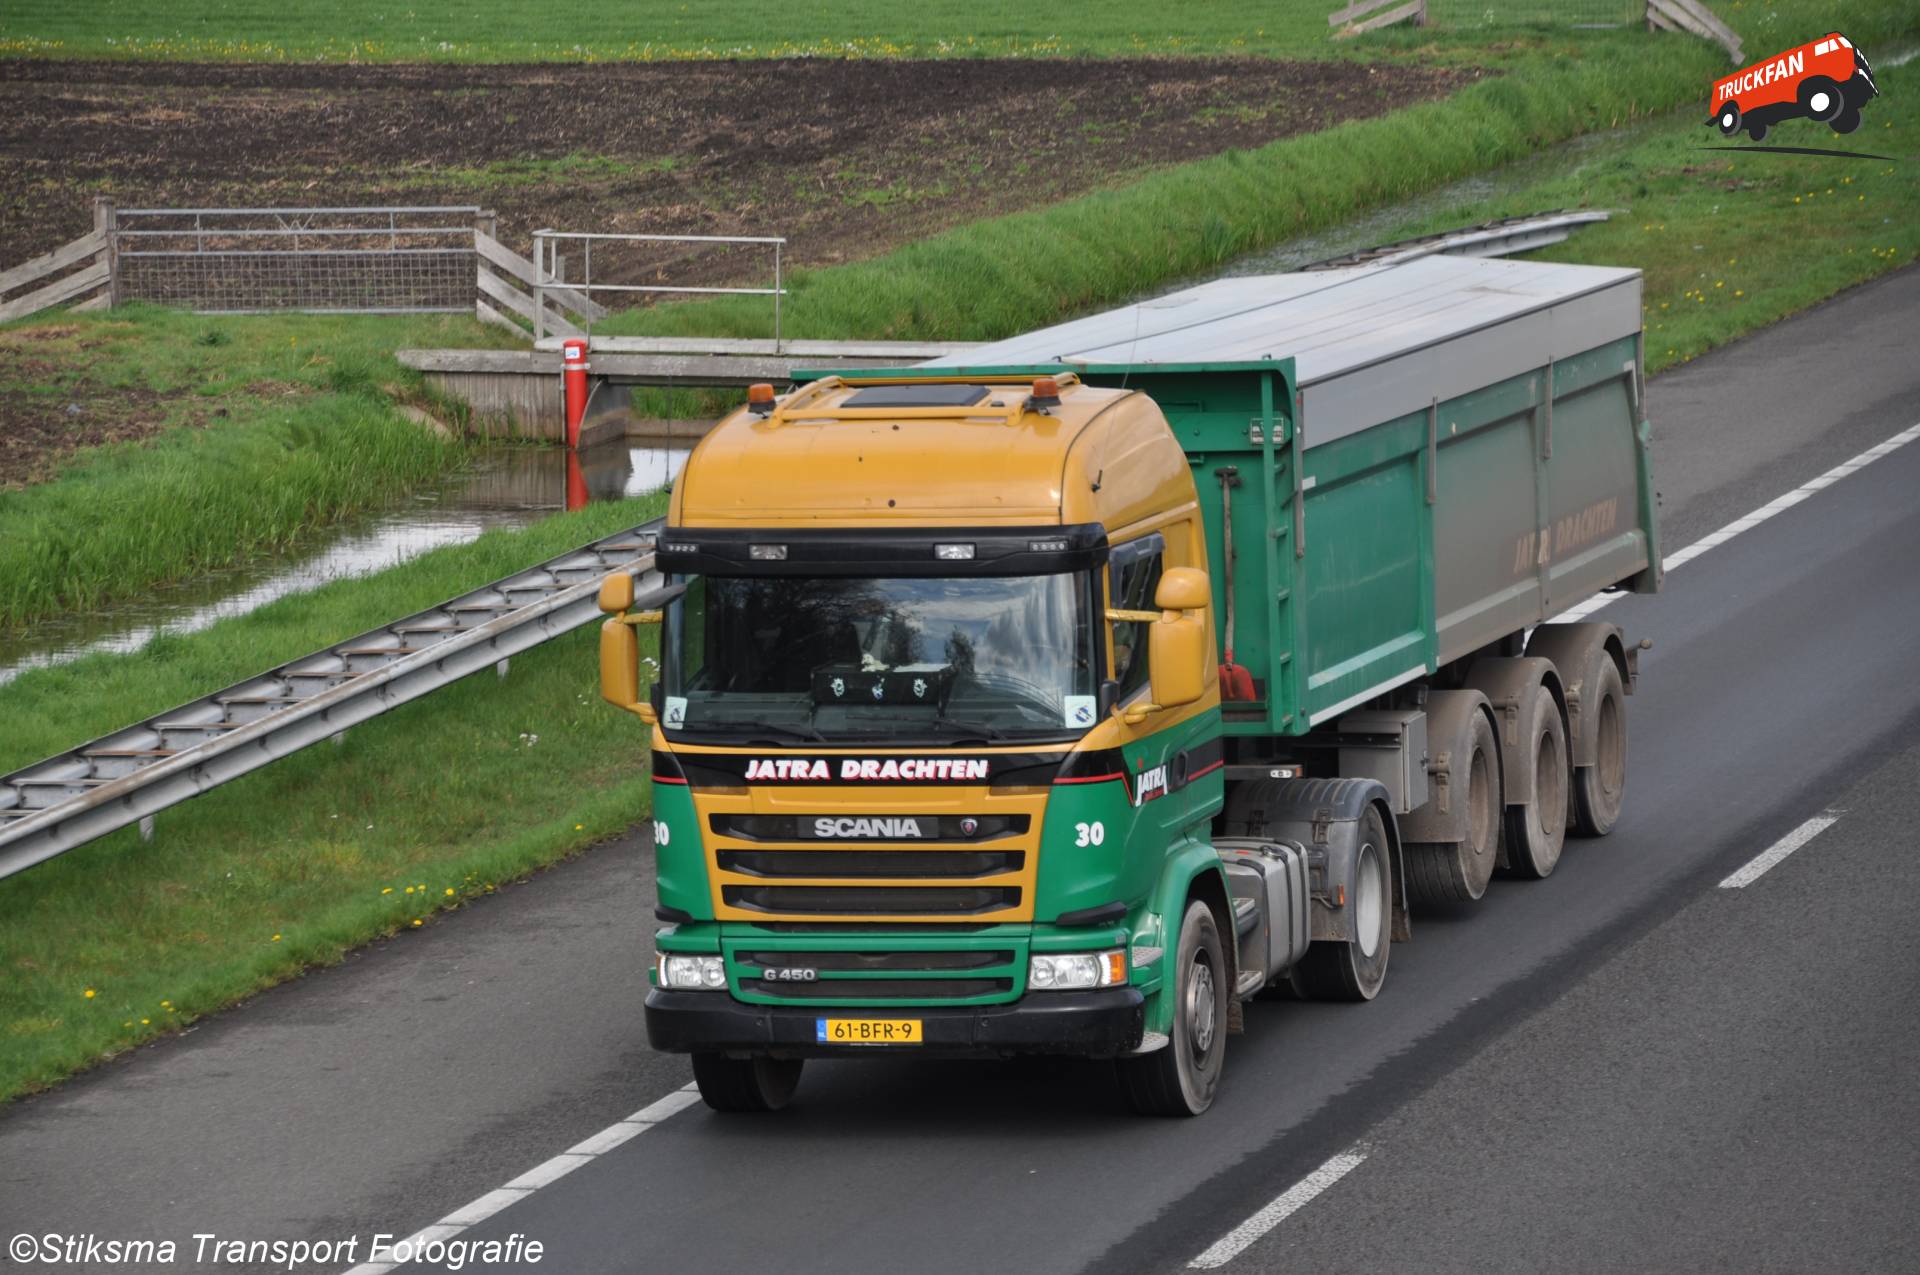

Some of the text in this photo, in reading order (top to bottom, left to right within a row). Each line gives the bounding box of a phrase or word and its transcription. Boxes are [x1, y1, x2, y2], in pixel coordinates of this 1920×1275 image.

[745, 760, 989, 780] JATRA DRACHTEN
[1135, 765, 1168, 807] JATRA
[814, 817, 922, 838] SCANIA
[1074, 821, 1104, 848] 30
[764, 969, 816, 981] G 450
[834, 1022, 912, 1039] 61-BFR-9
